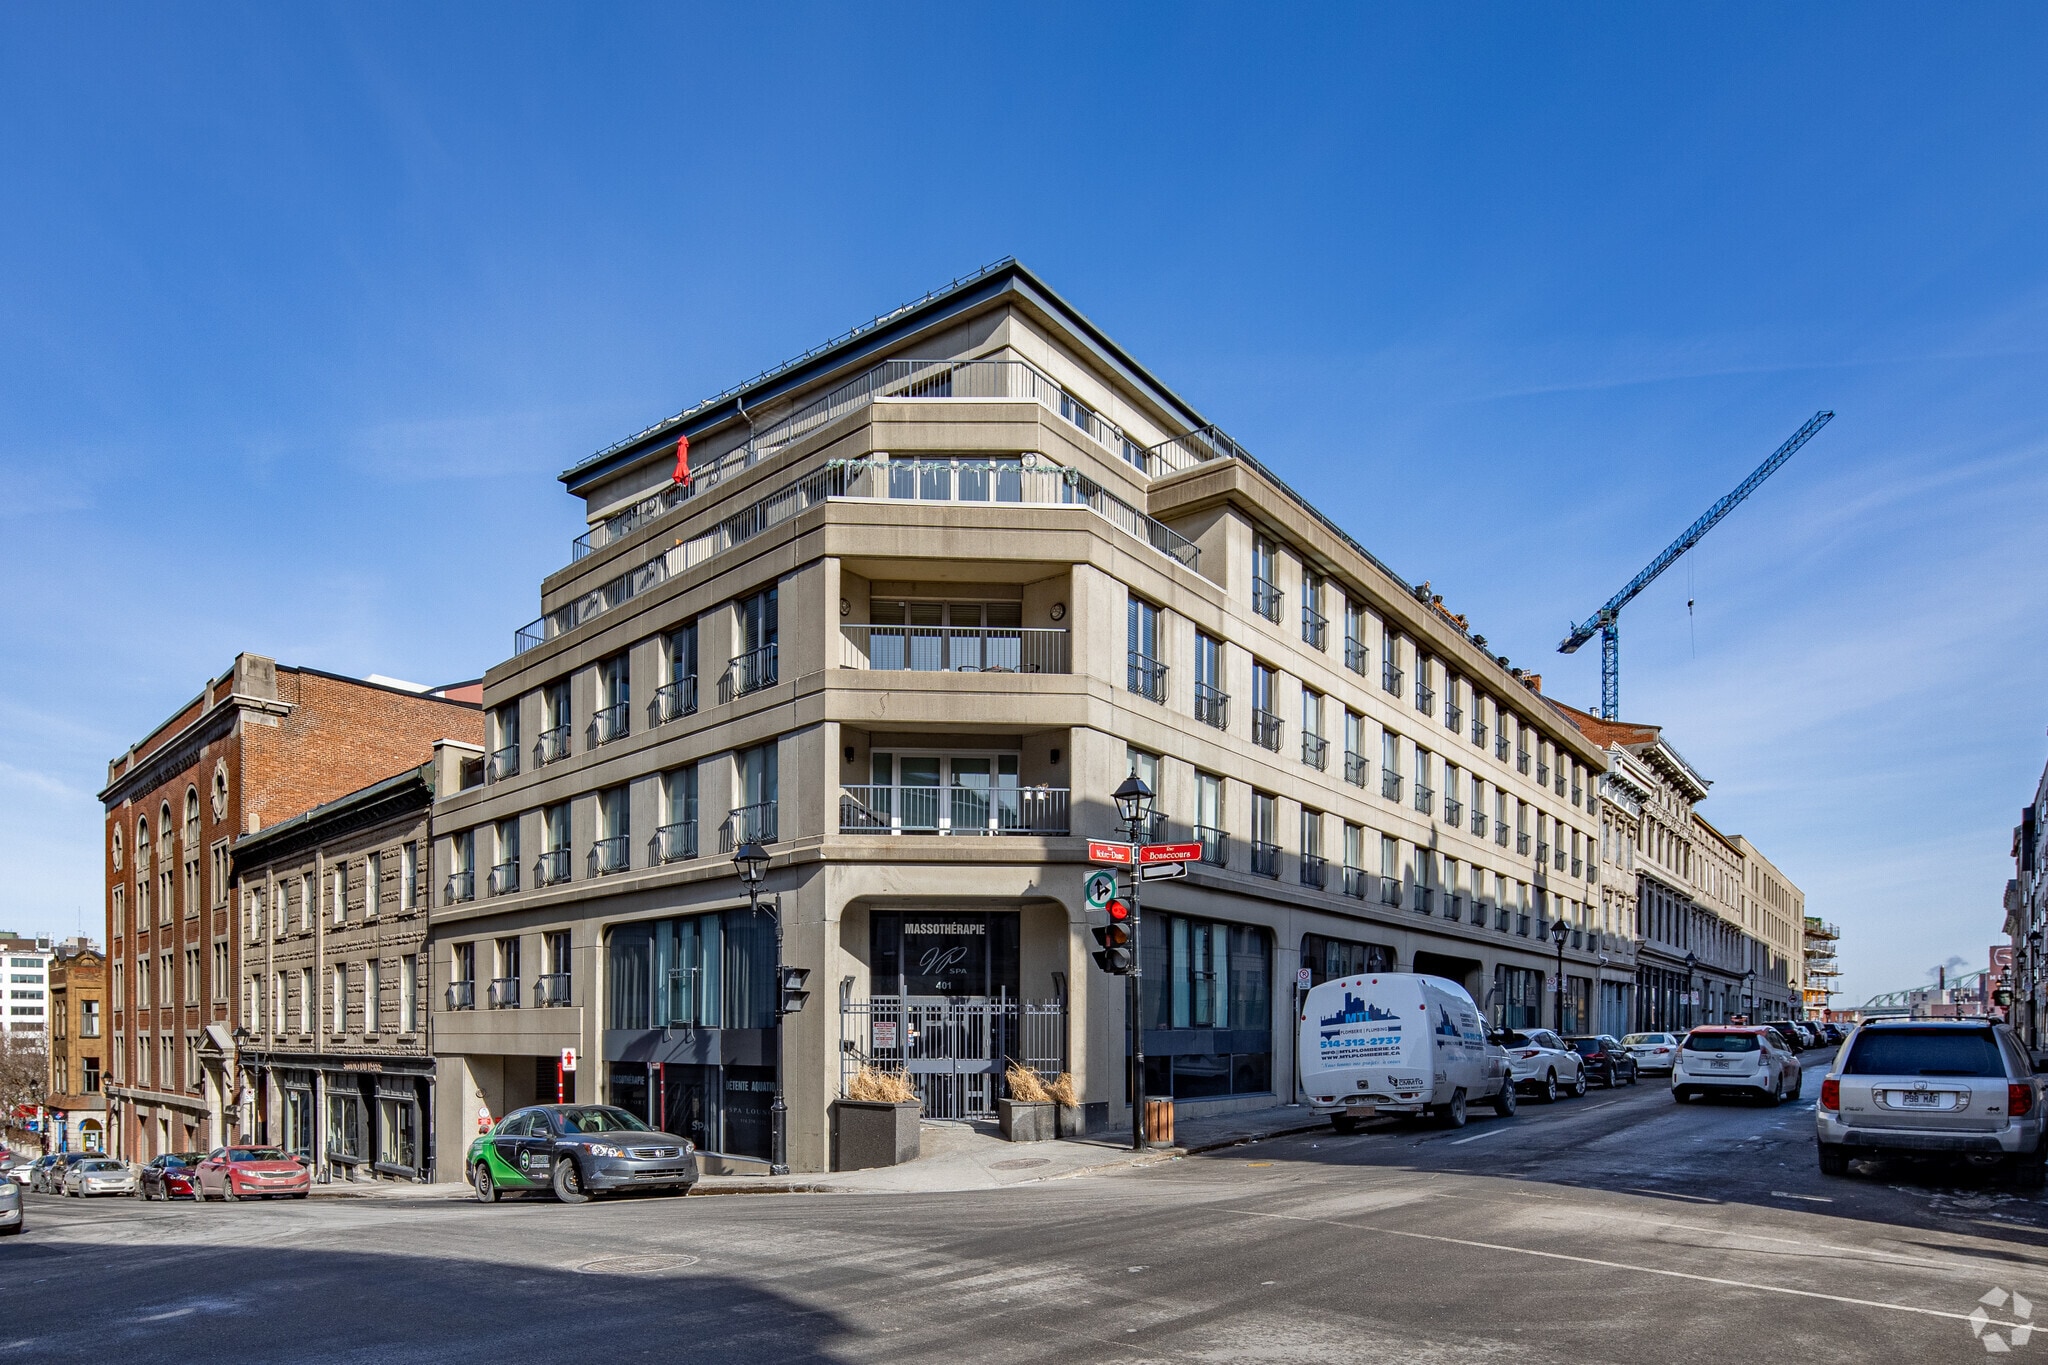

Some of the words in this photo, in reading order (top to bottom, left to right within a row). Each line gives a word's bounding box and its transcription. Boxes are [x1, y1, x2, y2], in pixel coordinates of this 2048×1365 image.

[1096, 849, 1125, 860] Notre-Dame
[1149, 851, 1191, 860] Bonsecours
[904, 921, 985, 935] MASSOTHÉRAPIE
[935, 981, 952, 990] 401
[1345, 1011, 1372, 1023] MTL
[1320, 1036, 1401, 1048] 514-312-2737
[1321, 1052, 1400, 1060] WWW.MTLPLOMBERIE.CA
[725, 1079, 749, 1091] DÉTENTE
[1923, 1095, 1938, 1103] MAF
[691, 1120, 710, 1132] SPA
